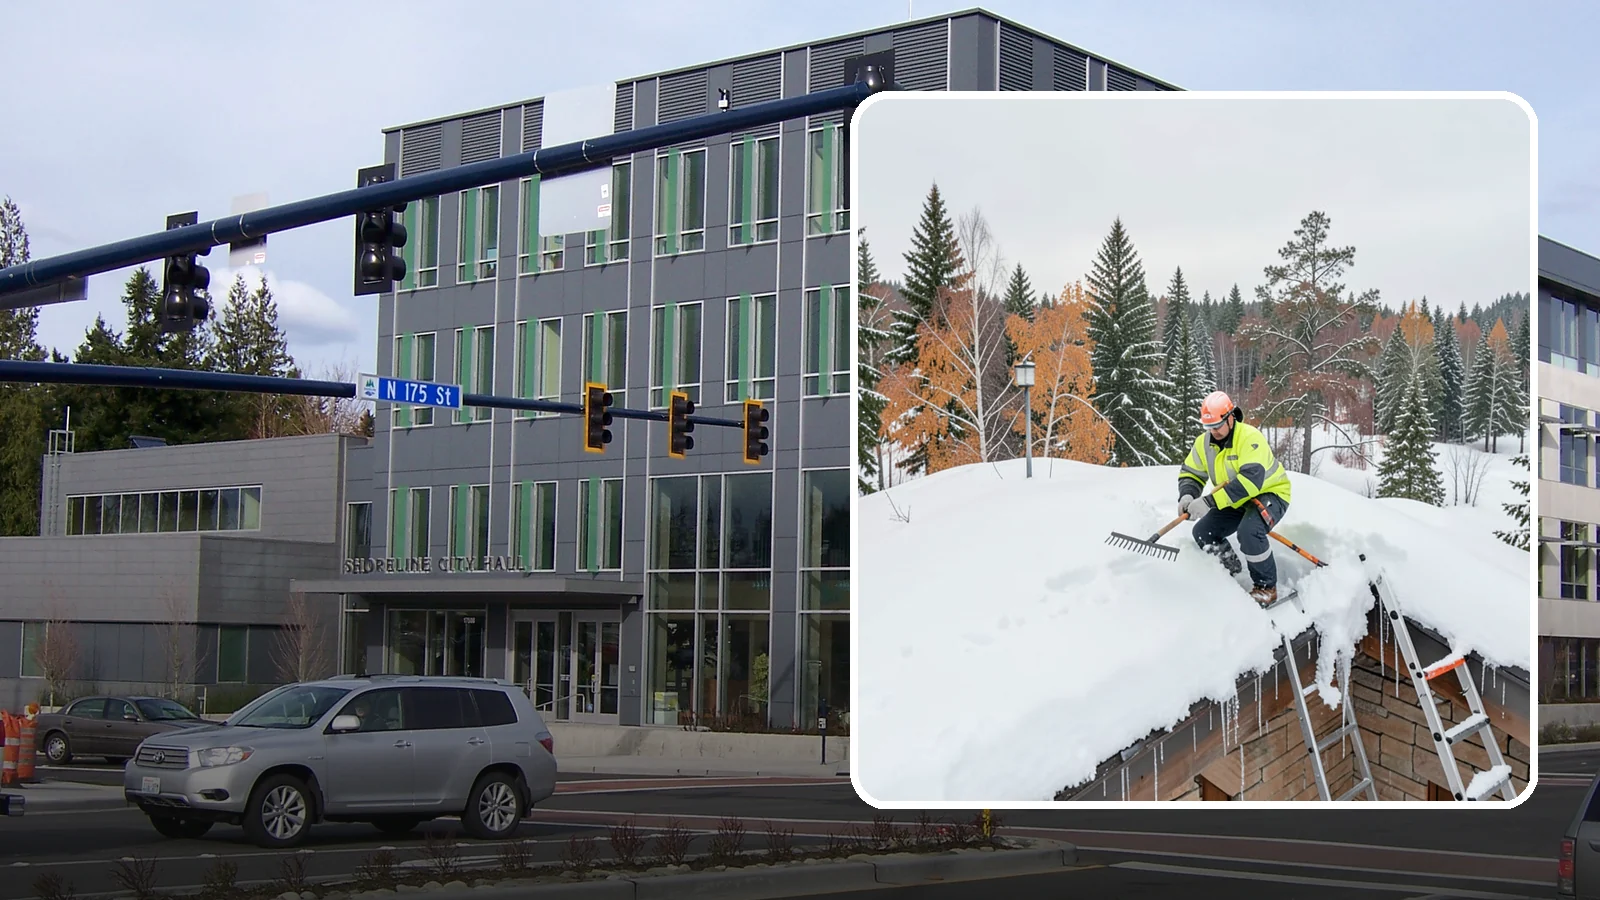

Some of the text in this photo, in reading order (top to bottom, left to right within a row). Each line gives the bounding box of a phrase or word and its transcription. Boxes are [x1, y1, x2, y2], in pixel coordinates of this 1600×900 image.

[387, 380, 452, 406] N 175 St
[344, 555, 526, 574] SHORELINE CITY HALL
